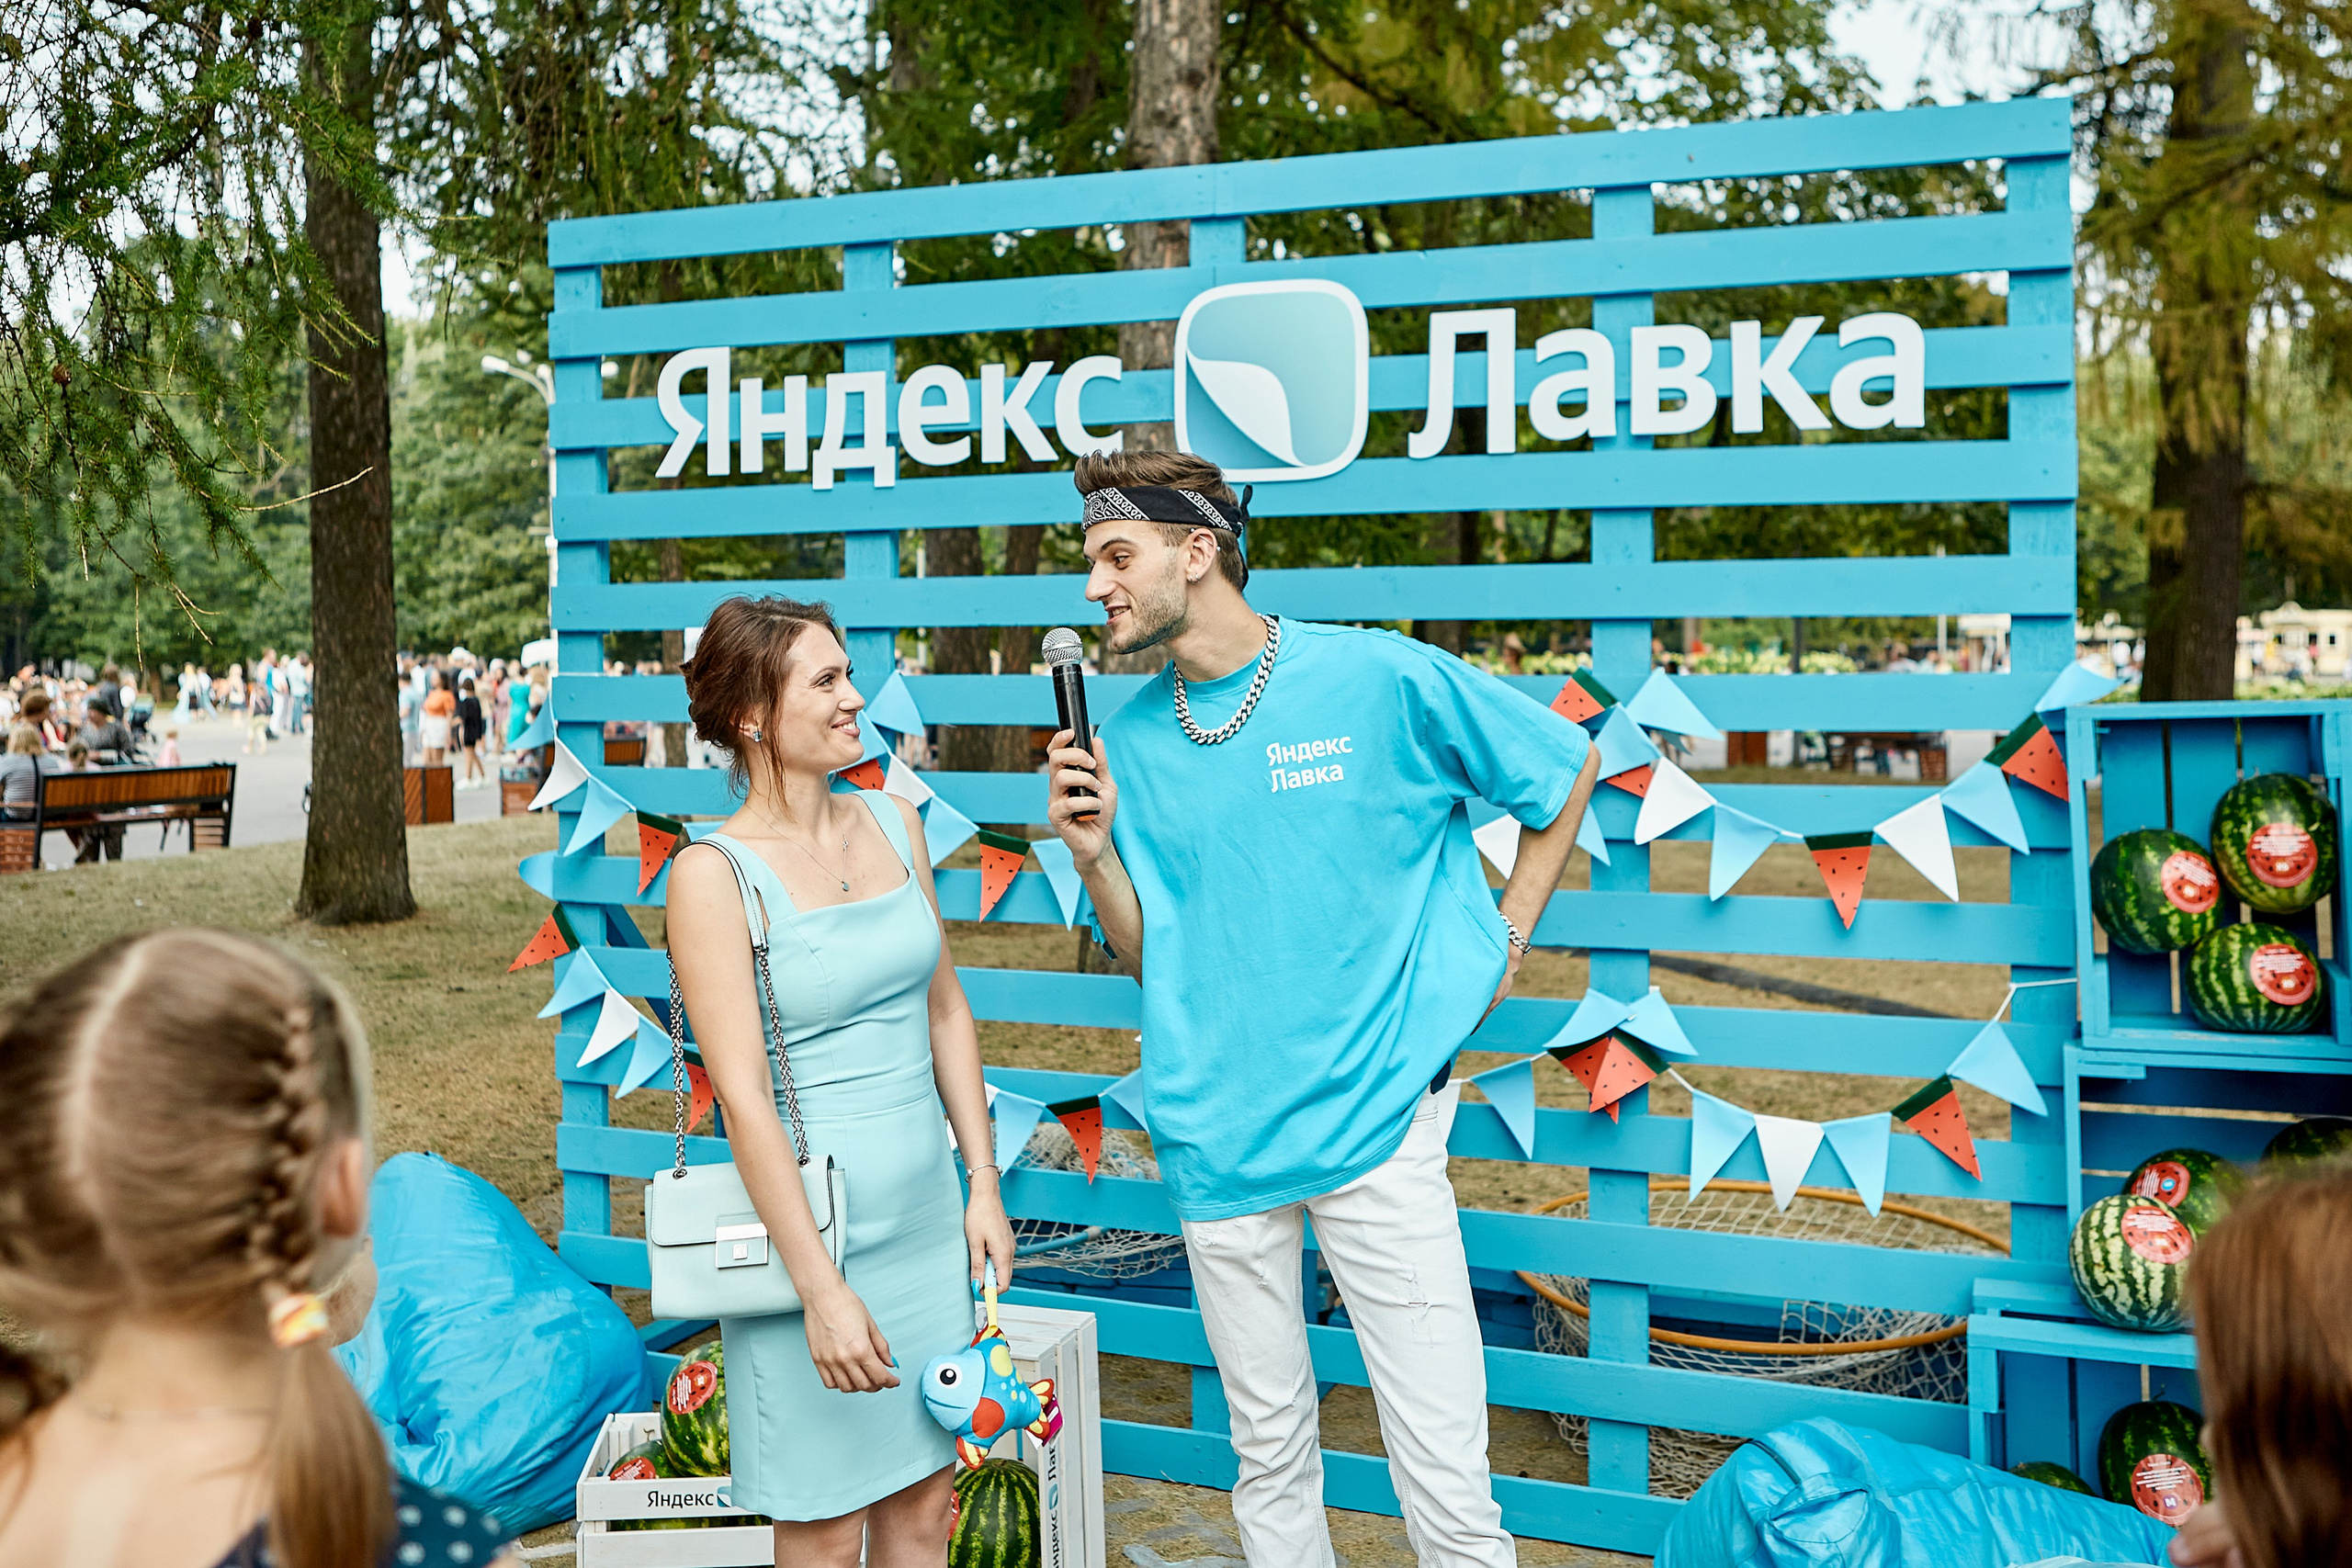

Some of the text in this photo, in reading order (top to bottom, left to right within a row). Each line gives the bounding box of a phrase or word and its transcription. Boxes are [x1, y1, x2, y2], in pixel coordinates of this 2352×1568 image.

[655, 308, 1926, 490] Яндекс Лавка
[1266, 737, 1352, 766] Яндекс
[1271, 764, 1344, 793] Лавка
[648, 1490, 714, 1508] Яндекс
[1051, 1509, 1059, 1568] ндекс
